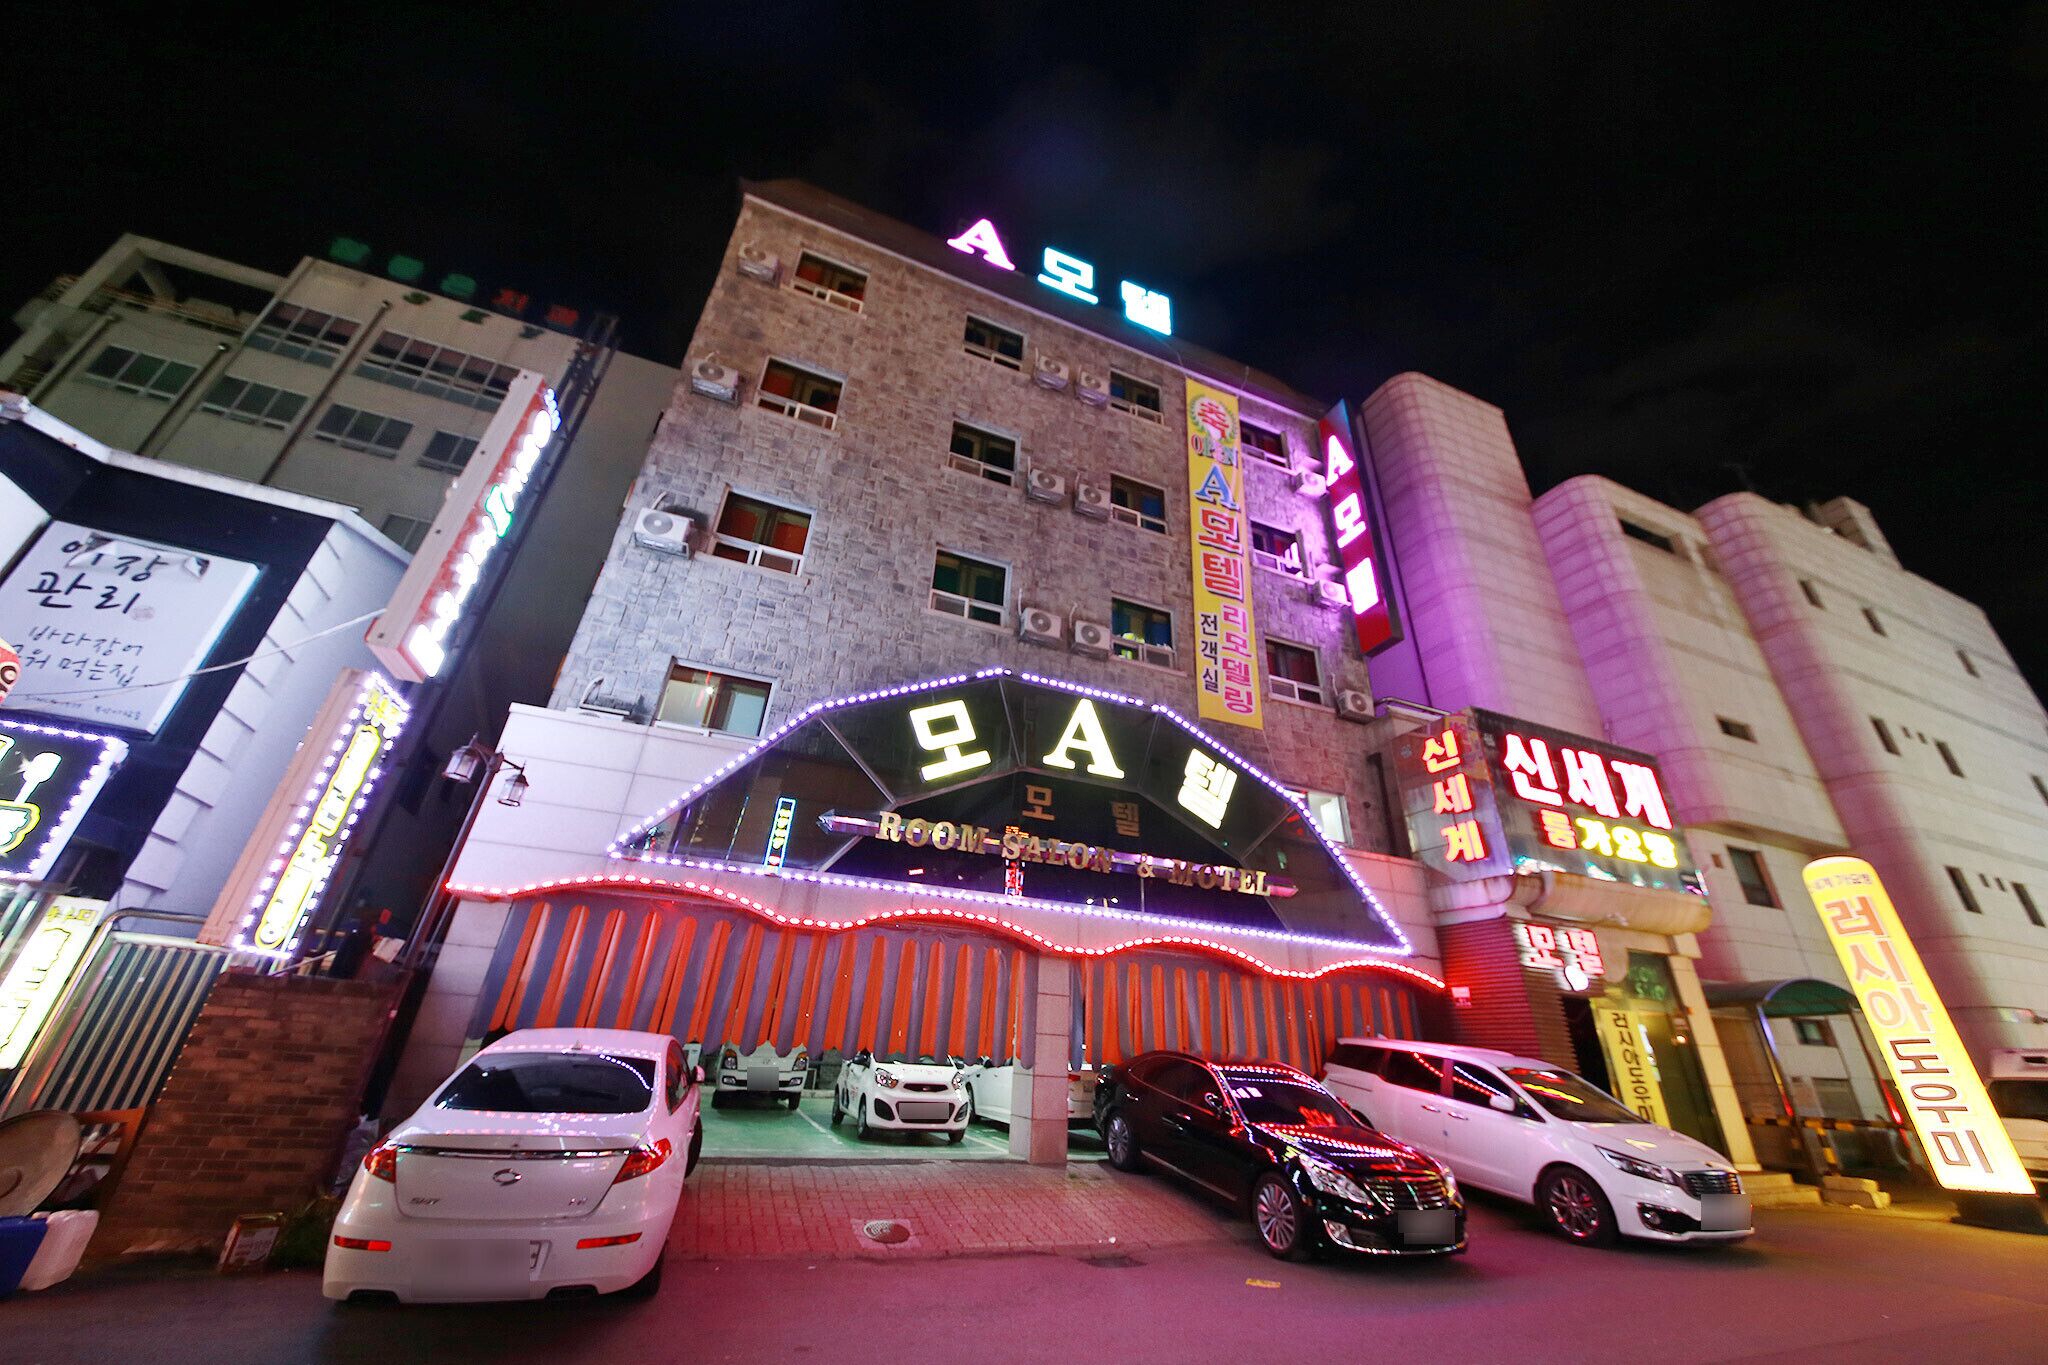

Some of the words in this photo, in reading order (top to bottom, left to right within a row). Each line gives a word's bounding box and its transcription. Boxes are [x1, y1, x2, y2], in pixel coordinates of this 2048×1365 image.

[1200, 612, 1220, 694] 전객실
[1222, 604, 1254, 714] 리모델링
[1422, 729, 1487, 863] 신세계
[1503, 732, 1674, 830] 신세계
[875, 811, 990, 855] ROOM
[1001, 832, 1117, 874] SALON
[1136, 853, 1155, 878] &
[1167, 858, 1272, 897] MOTEL
[1516, 923, 1606, 976] 모텔
